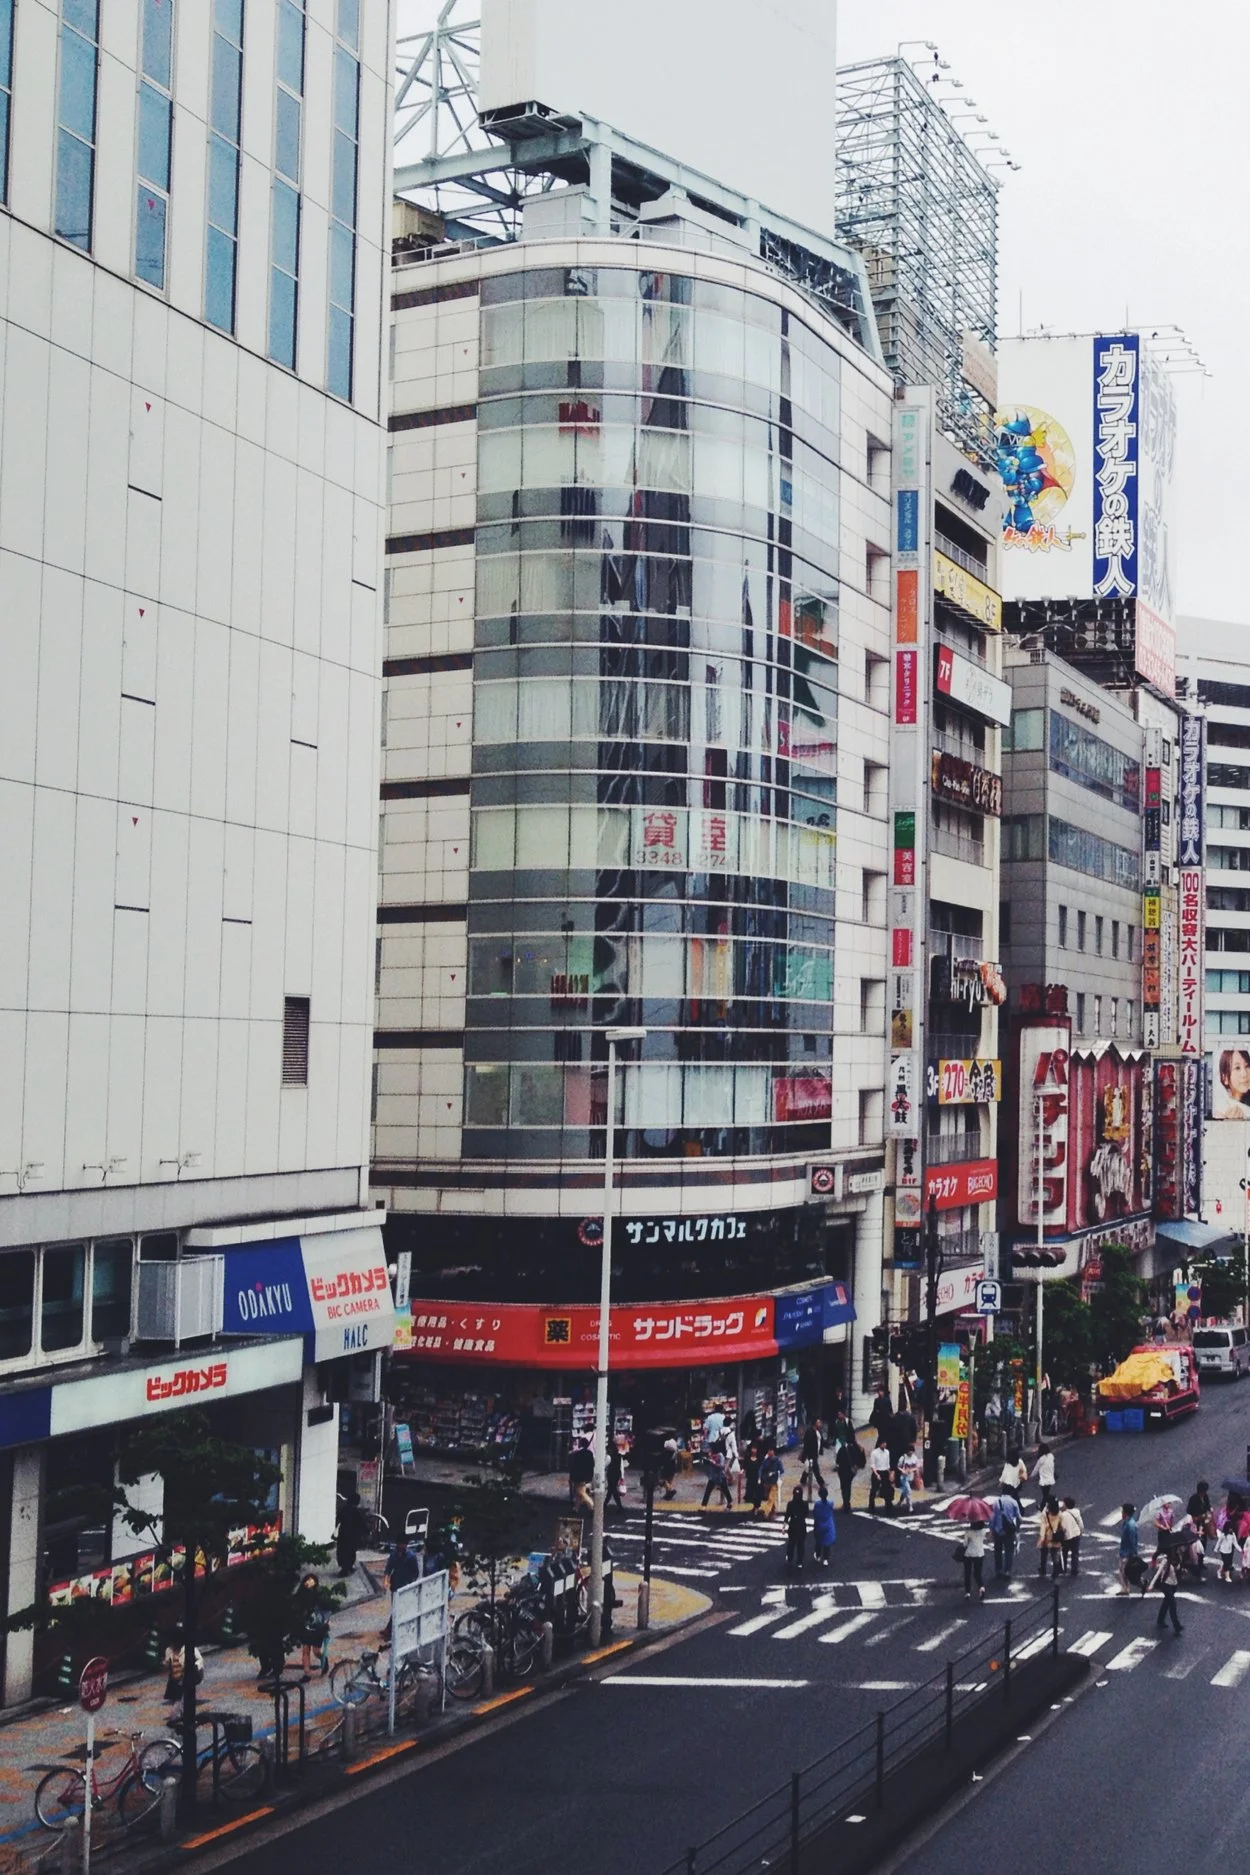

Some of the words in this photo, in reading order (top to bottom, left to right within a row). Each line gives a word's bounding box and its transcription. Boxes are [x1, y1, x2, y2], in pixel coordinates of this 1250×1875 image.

[1094, 343, 1137, 598] カラオケの鉄人
[939, 660, 951, 682] 7F
[1181, 716, 1201, 865] カラオケの鉄人
[643, 812, 678, 848] 貸
[635, 851, 683, 865] 3348
[902, 851, 913, 884] 美容室
[1181, 872, 1200, 1054] 100名収容大パーティールーム
[927, 1065, 939, 1097] 3F
[944, 1063, 965, 1099] 270
[1030, 1047, 1069, 1215] パチンコ
[928, 1176, 959, 1200] カラオケ
[625, 1216, 748, 1244] サンマルクカフェ
[311, 1266, 388, 1302] ビックカメラ
[238, 1282, 293, 1321] ODAKYU
[327, 1304, 343, 1320] BIC
[343, 1298, 381, 1317] CAMERA
[343, 1323, 369, 1349] HALC
[633, 1311, 745, 1341] サンドラッグ
[146, 1363, 228, 1401] ビックカメラ
